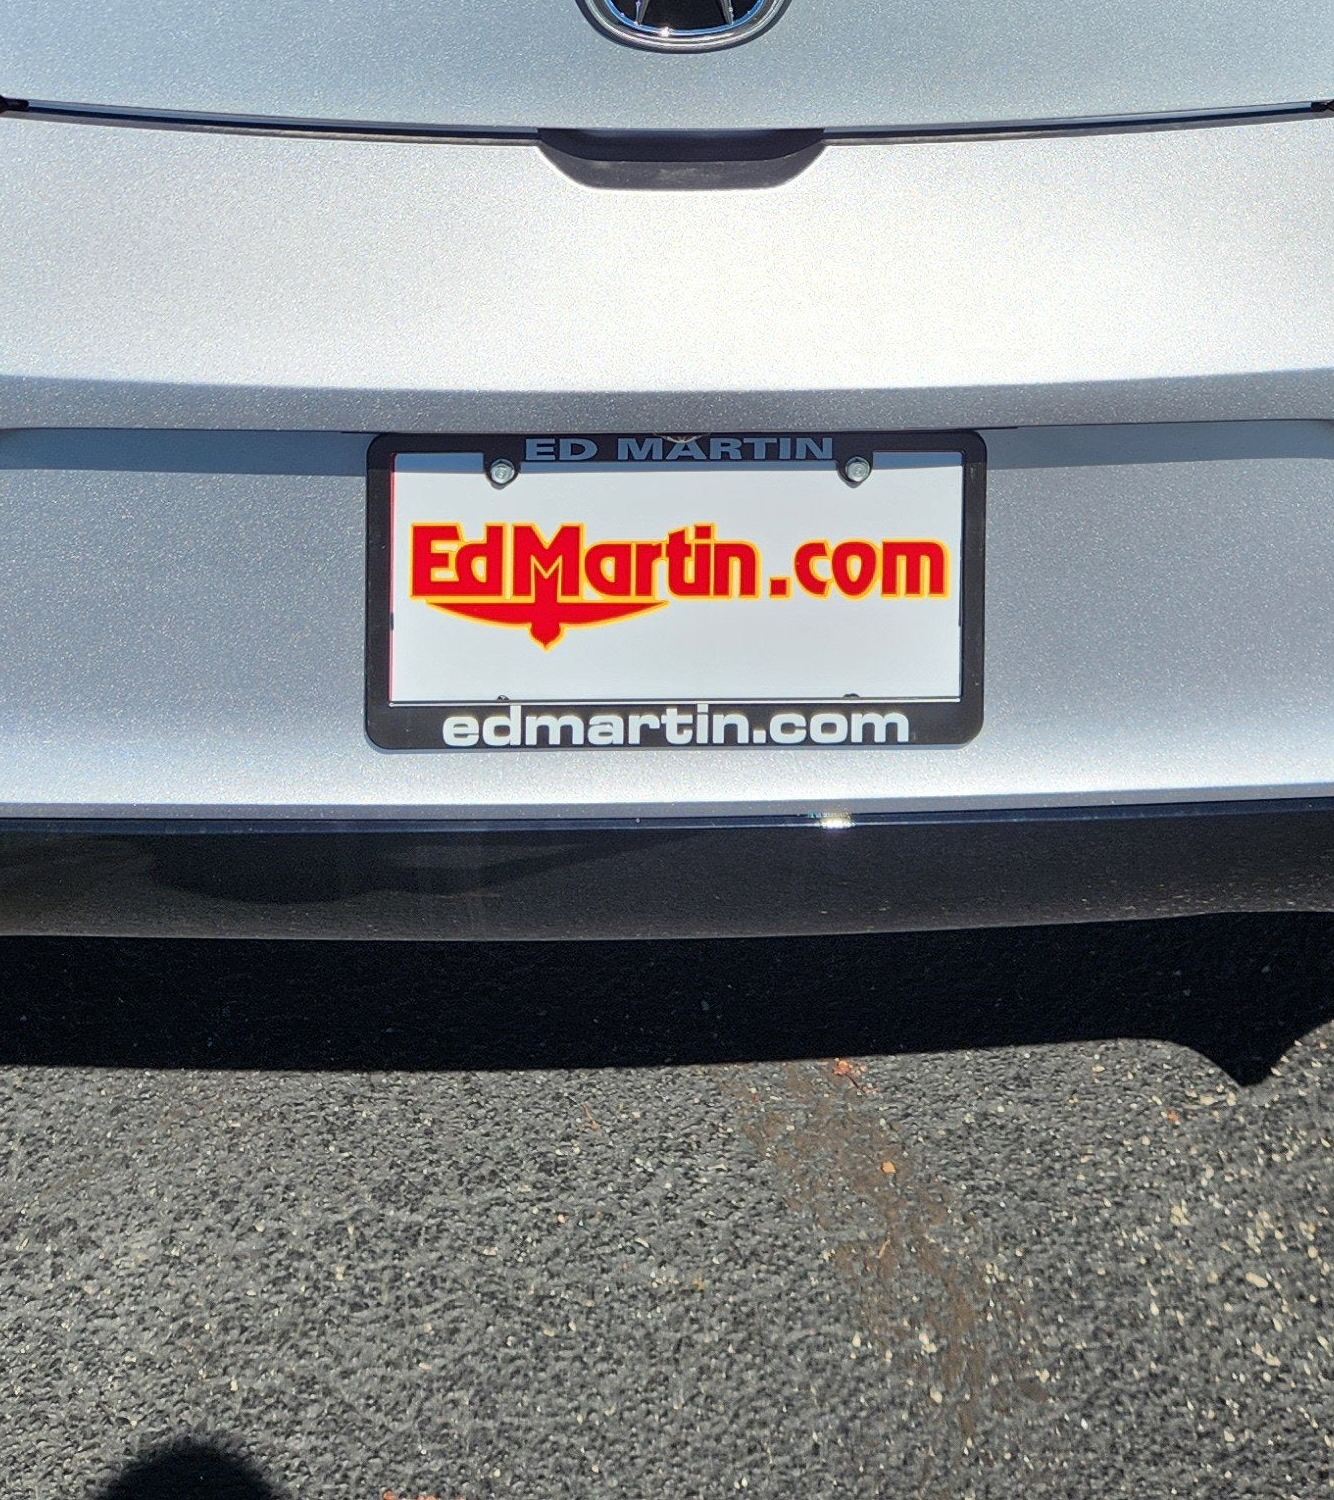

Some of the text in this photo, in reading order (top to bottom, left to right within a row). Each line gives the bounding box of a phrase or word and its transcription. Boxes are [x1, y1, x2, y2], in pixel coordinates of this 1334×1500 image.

[524, 437, 834, 461] ED MARTIN
[410, 522, 951, 599] EdMartin.com
[443, 703, 910, 747] edmartin.com
